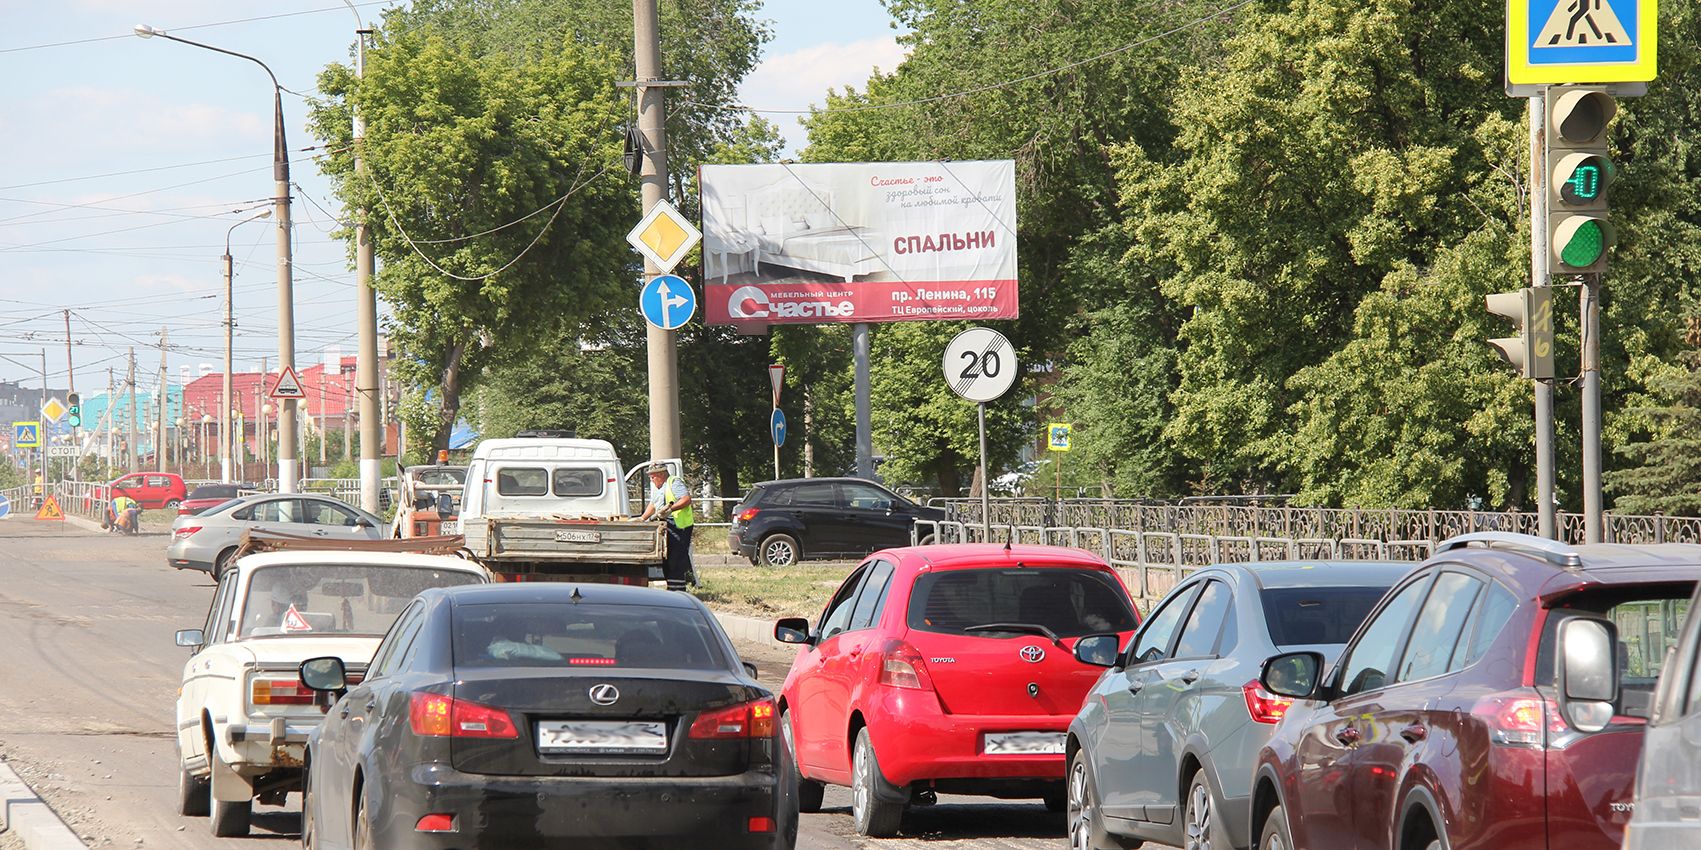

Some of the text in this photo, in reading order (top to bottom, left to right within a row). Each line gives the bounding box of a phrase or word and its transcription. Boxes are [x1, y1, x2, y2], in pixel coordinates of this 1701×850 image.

[870, 175, 914, 187] Счастье
[923, 175, 944, 183] это
[886, 185, 932, 202] здоровый
[914, 195, 959, 207] любимой
[961, 191, 1002, 208] кровати
[894, 230, 995, 255] СПАЛЬНИ
[728, 286, 854, 318] Счастье
[770, 290, 854, 299] МЕБЕЛЬНЫЙ ЦЕНТР
[891, 287, 996, 302] пр. Ленина, 115
[892, 304, 998, 315] ТЦ Европейский, цоколь
[960, 350, 1001, 378] 20
